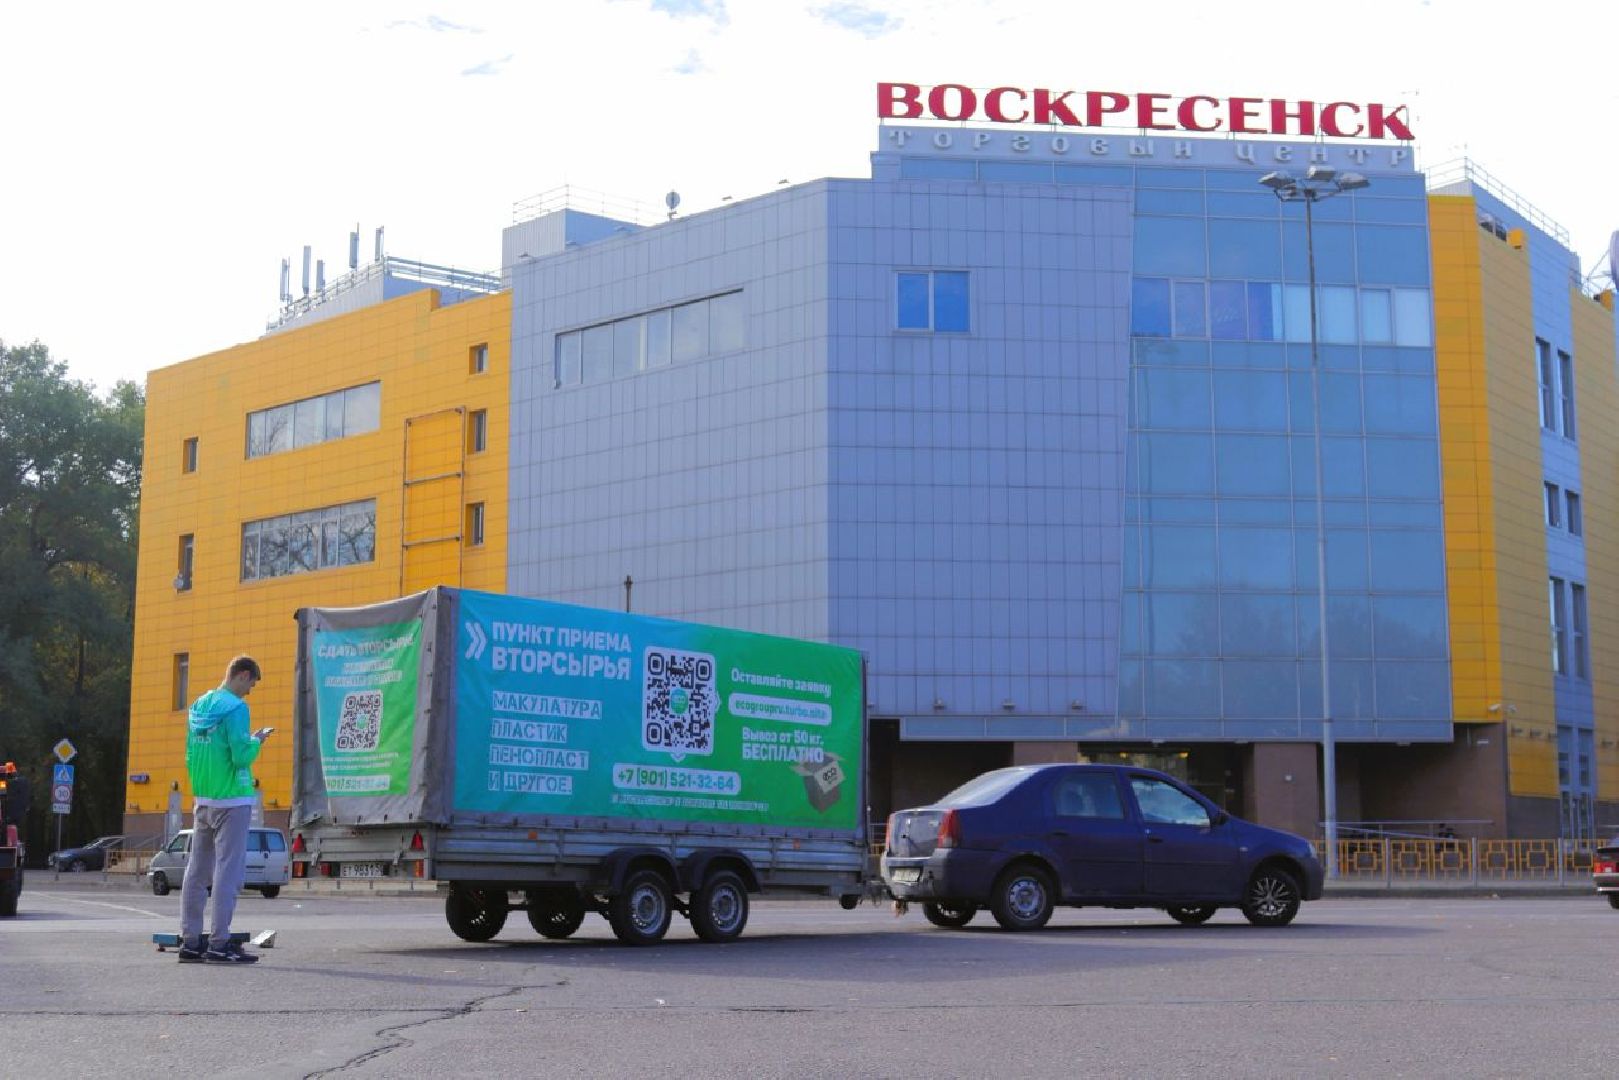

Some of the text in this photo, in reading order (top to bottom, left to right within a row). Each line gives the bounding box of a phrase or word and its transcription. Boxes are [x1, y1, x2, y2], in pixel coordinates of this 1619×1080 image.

[877, 82, 1415, 140] ВОСКРЕСЕНСК
[492, 621, 632, 653] ПУНКТ ПРИЕМА
[492, 646, 632, 681] ВТОРСЫРЬЯ
[493, 692, 601, 718] МАКУЛАТУРА
[492, 720, 566, 742] ПЛАСТИК
[794, 729, 809, 744] 50
[490, 746, 588, 769] ПЕНОПЛАСТ
[742, 743, 825, 763] БЕСПЛАТНО
[489, 771, 499, 790] И
[618, 768, 634, 784] +7
[636, 767, 668, 789] (901)
